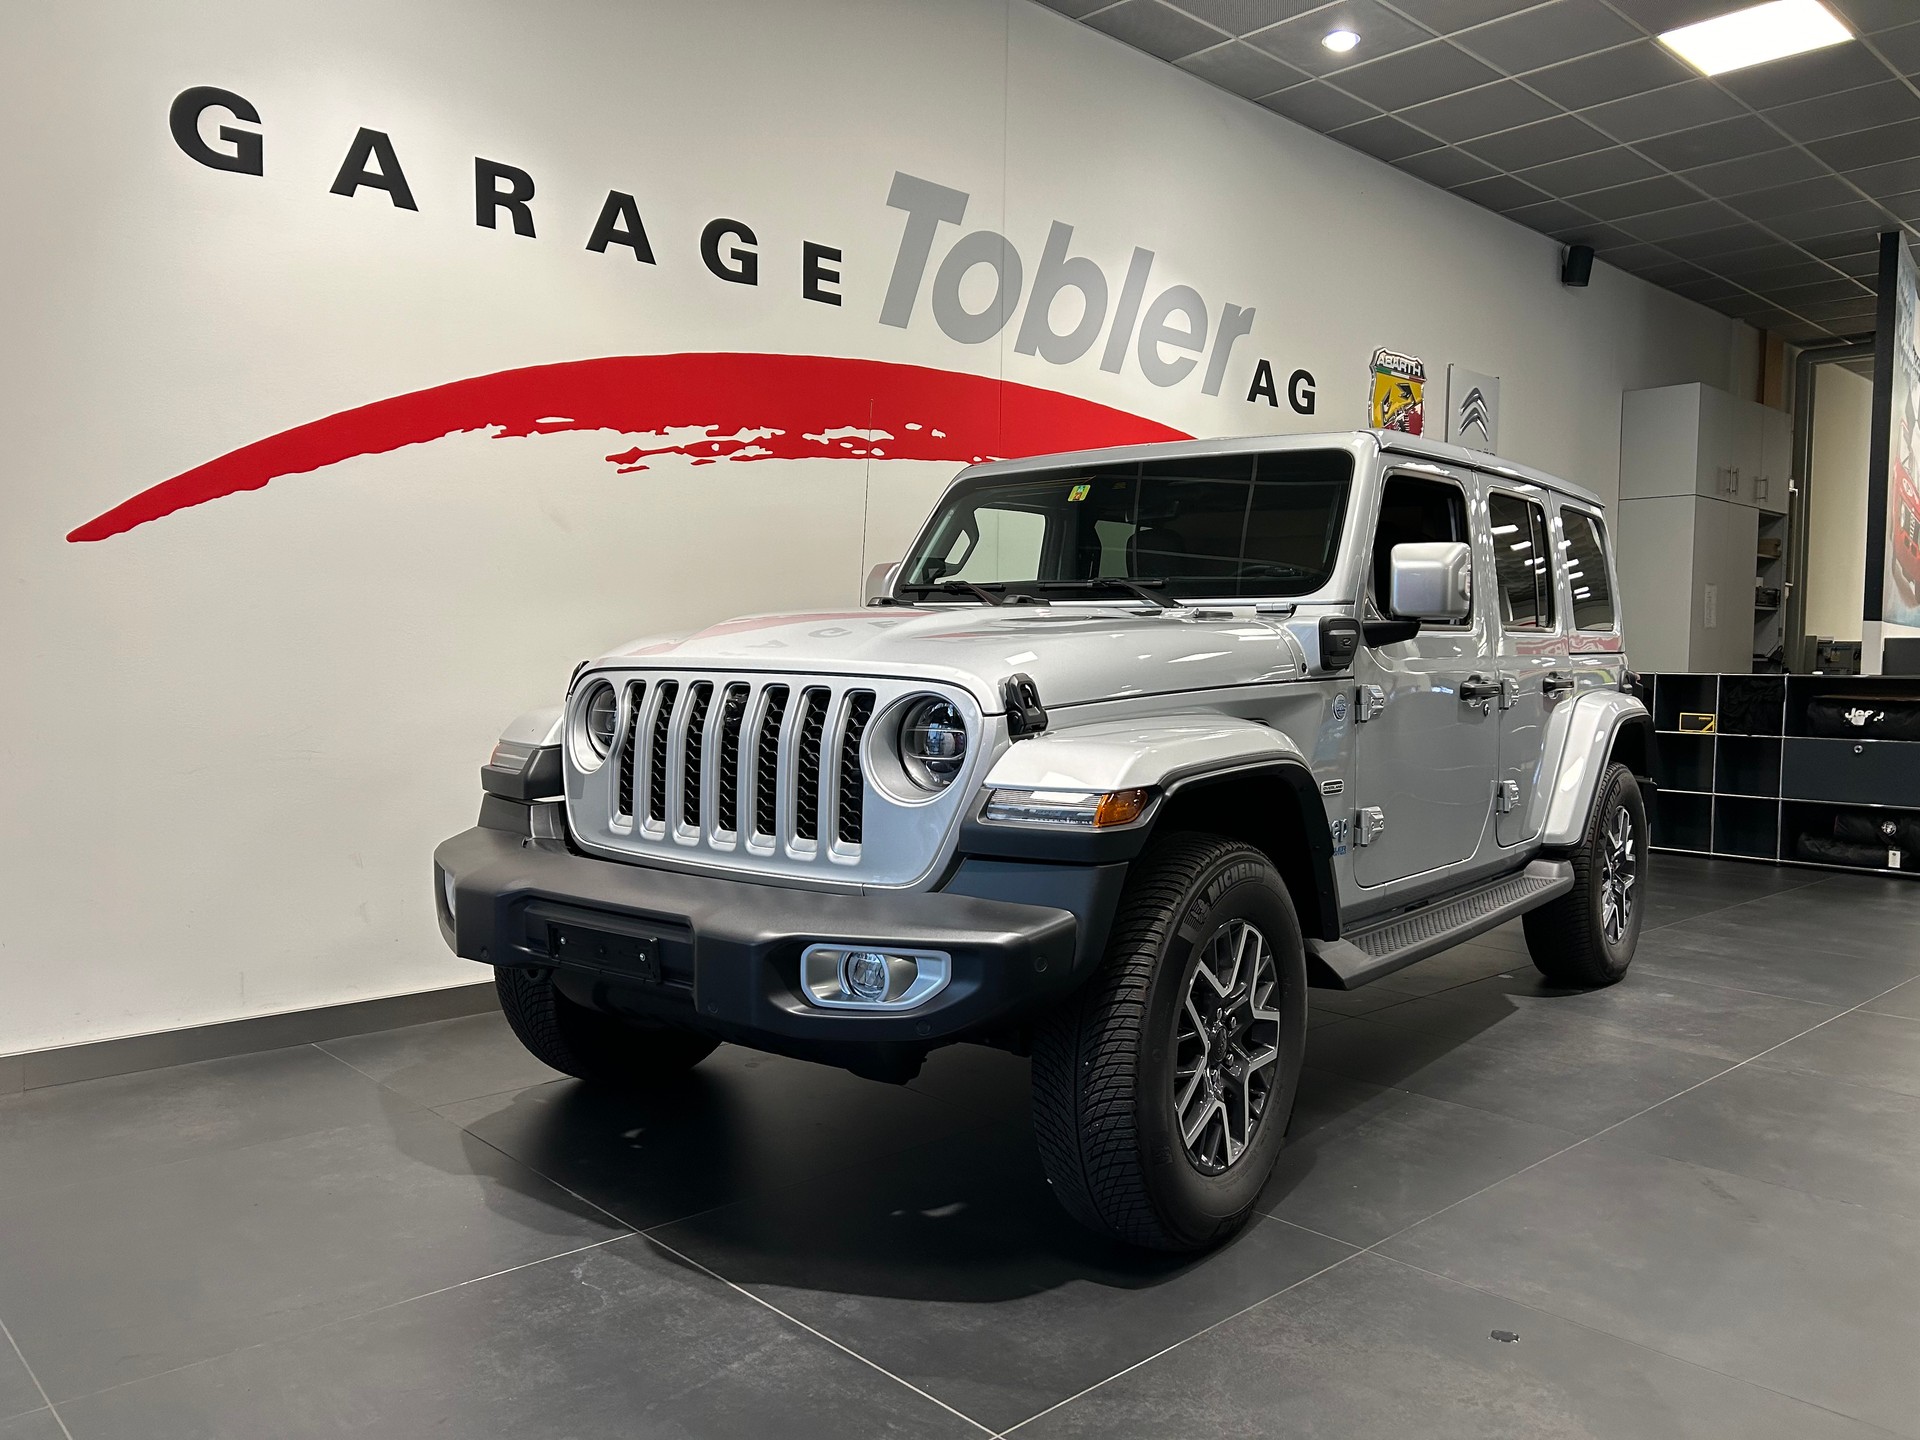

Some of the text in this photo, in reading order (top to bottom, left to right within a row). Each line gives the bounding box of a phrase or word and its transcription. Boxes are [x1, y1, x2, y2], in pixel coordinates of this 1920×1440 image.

[169, 85, 1316, 415] GARAGE Tobler AG
[1376, 352, 1422, 377] ABARTH
[1207, 862, 1265, 904] MICHELIN
